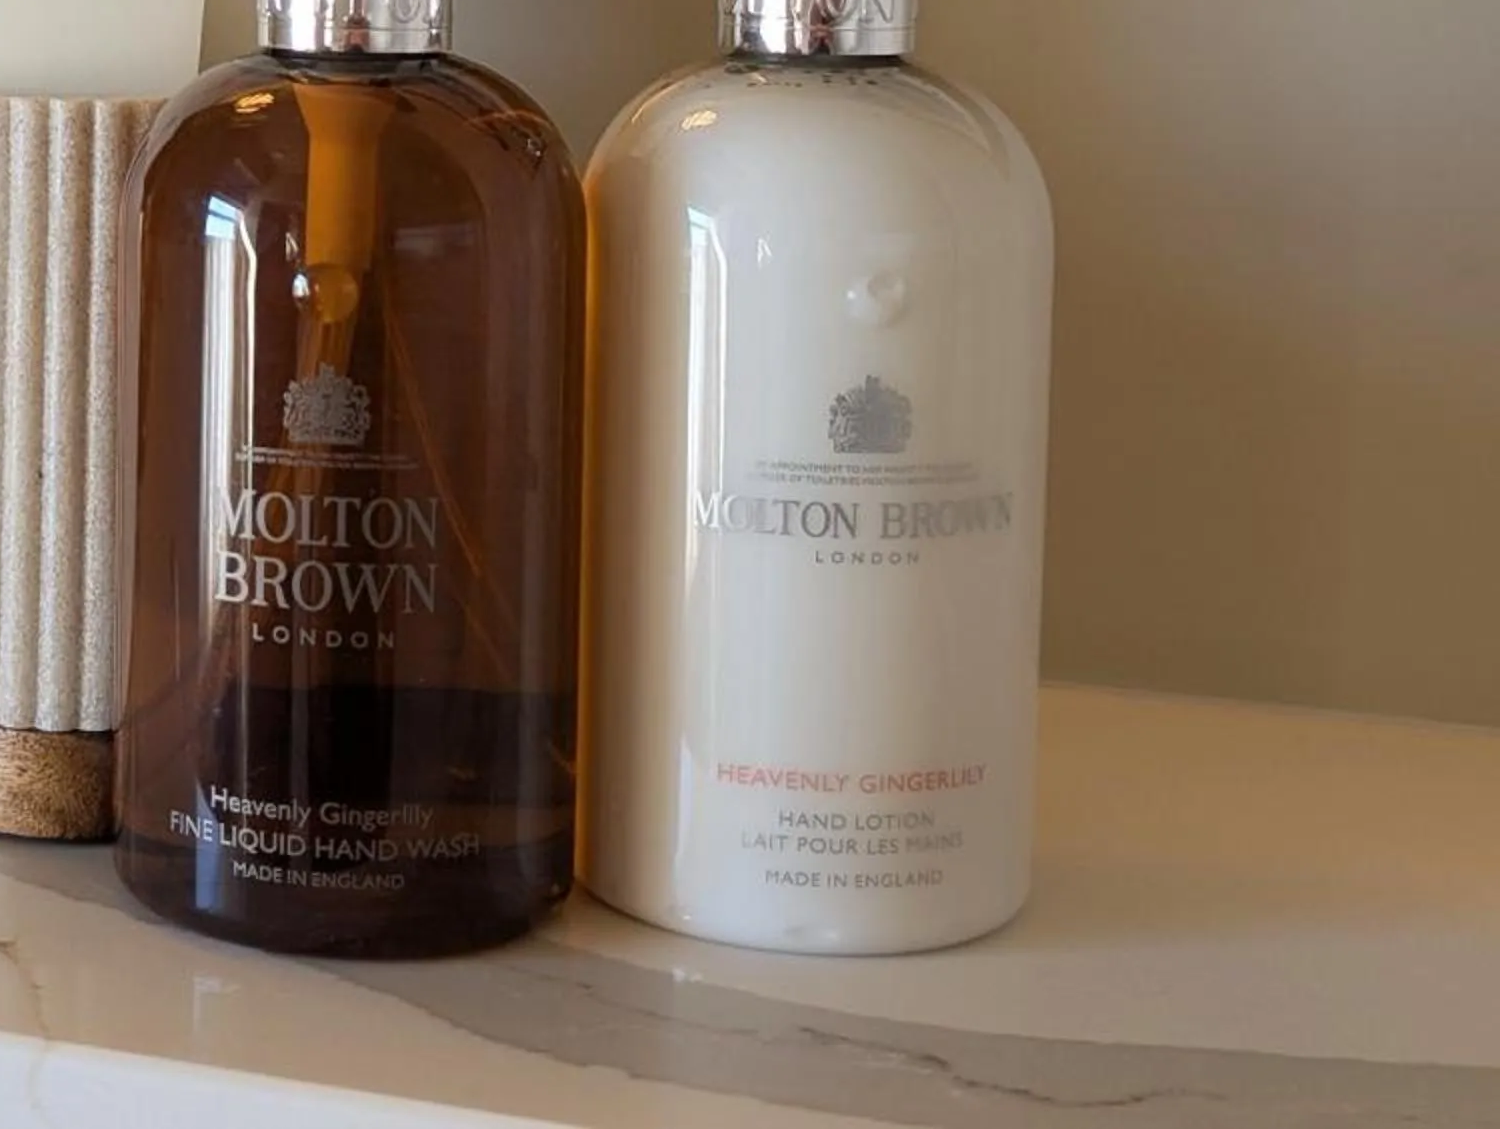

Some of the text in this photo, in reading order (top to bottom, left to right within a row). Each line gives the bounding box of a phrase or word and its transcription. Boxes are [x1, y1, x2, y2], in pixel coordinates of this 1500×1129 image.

[216, 487, 438, 549] MOLTON
[693, 488, 1014, 540] MOLTON BROWN
[815, 550, 920, 564] LONDON
[214, 550, 438, 613] BROWN
[252, 622, 395, 649] LONDON
[717, 762, 987, 794] HEAVENLY GINGERLILY
[210, 784, 434, 832] Heavenly Gingerlily
[778, 811, 935, 831] HAND LOTION
[169, 809, 480, 861] FINE LIQUID HAND WASH
[741, 831, 964, 855] LAIT POUR LES MAINS
[233, 860, 405, 890] MADE IN ENGLAND
[765, 870, 945, 889] MADE IN ENGLAND
